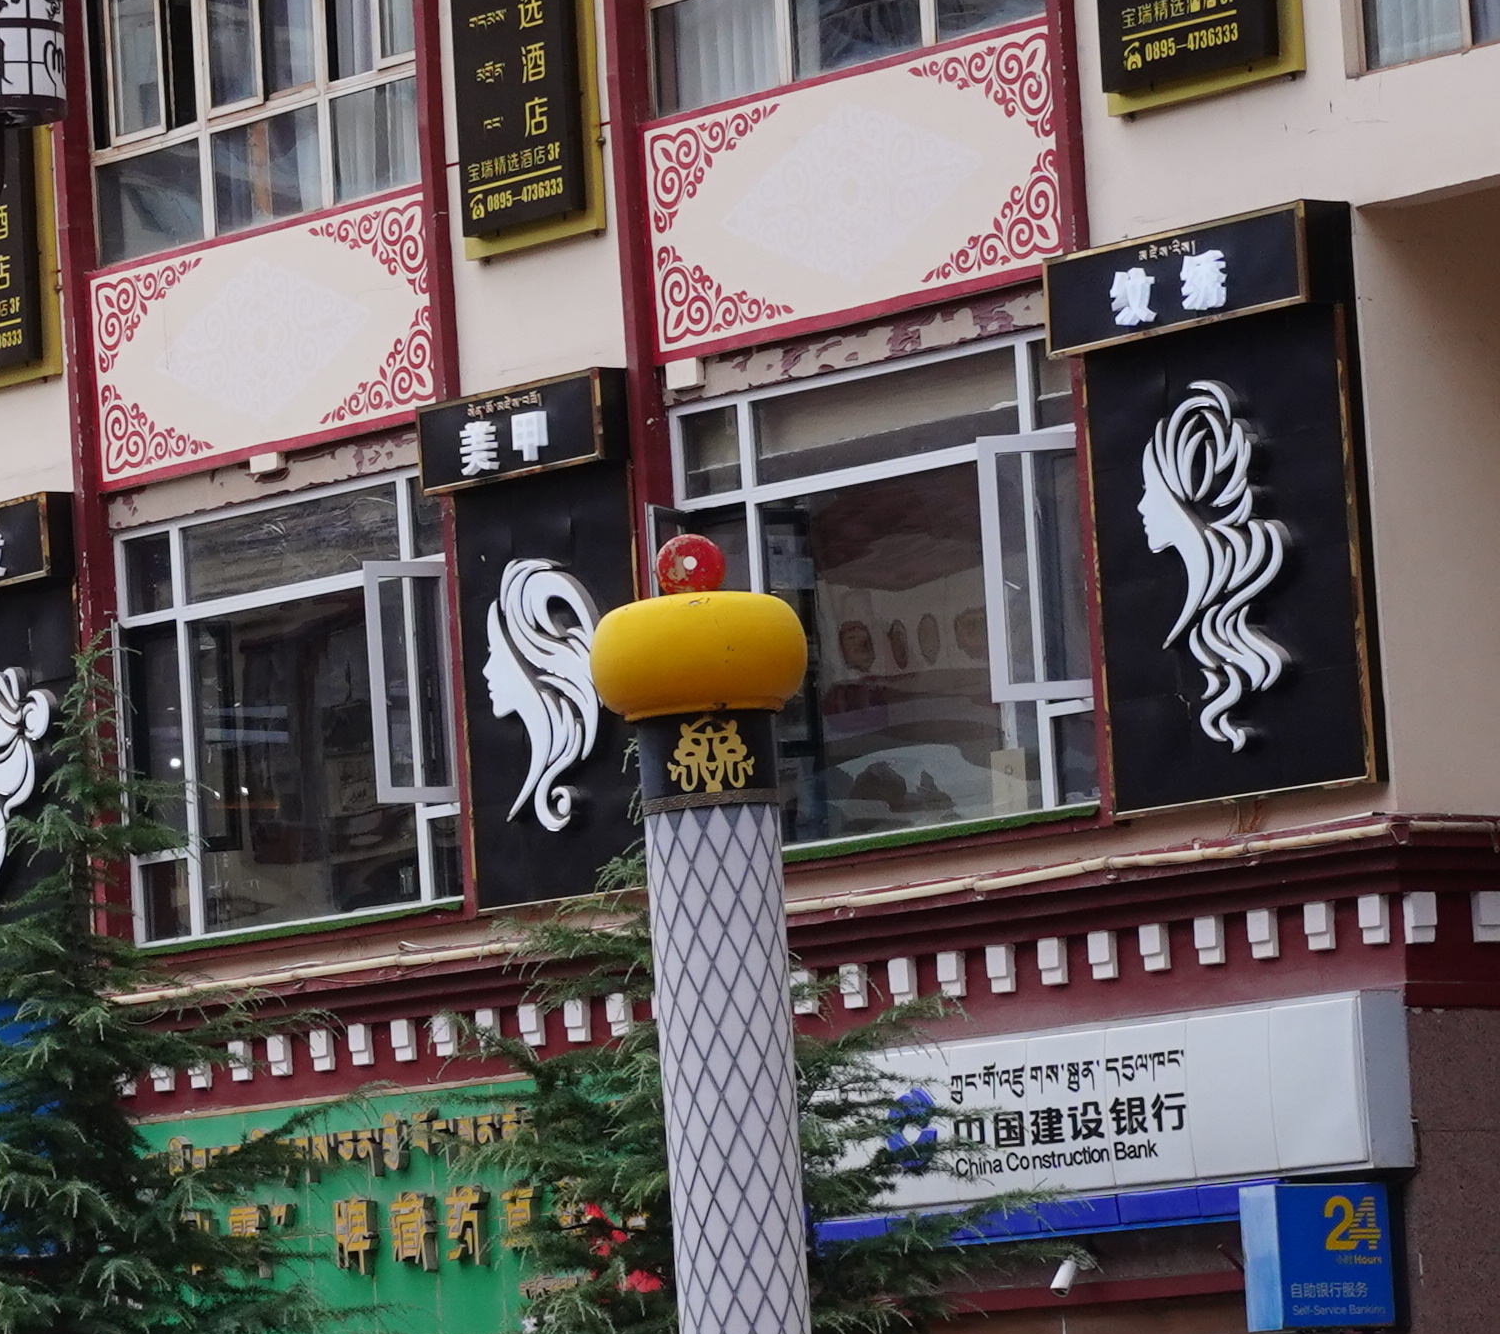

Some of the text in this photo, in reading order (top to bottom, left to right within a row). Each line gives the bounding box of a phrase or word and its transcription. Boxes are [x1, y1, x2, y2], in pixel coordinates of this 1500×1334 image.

[467, 141, 561, 183] 宝瑞精选酒店 3F
[9, 296, 21, 315] 3F
[459, 410, 550, 477] 美甲
[952, 1091, 1188, 1151] 中国建设银行
[954, 1155, 1004, 1178] China
[1114, 1138, 1160, 1162] Bank
[1323, 1195, 1383, 1251] 24
[1289, 1281, 1370, 1300] 自助银行服务
